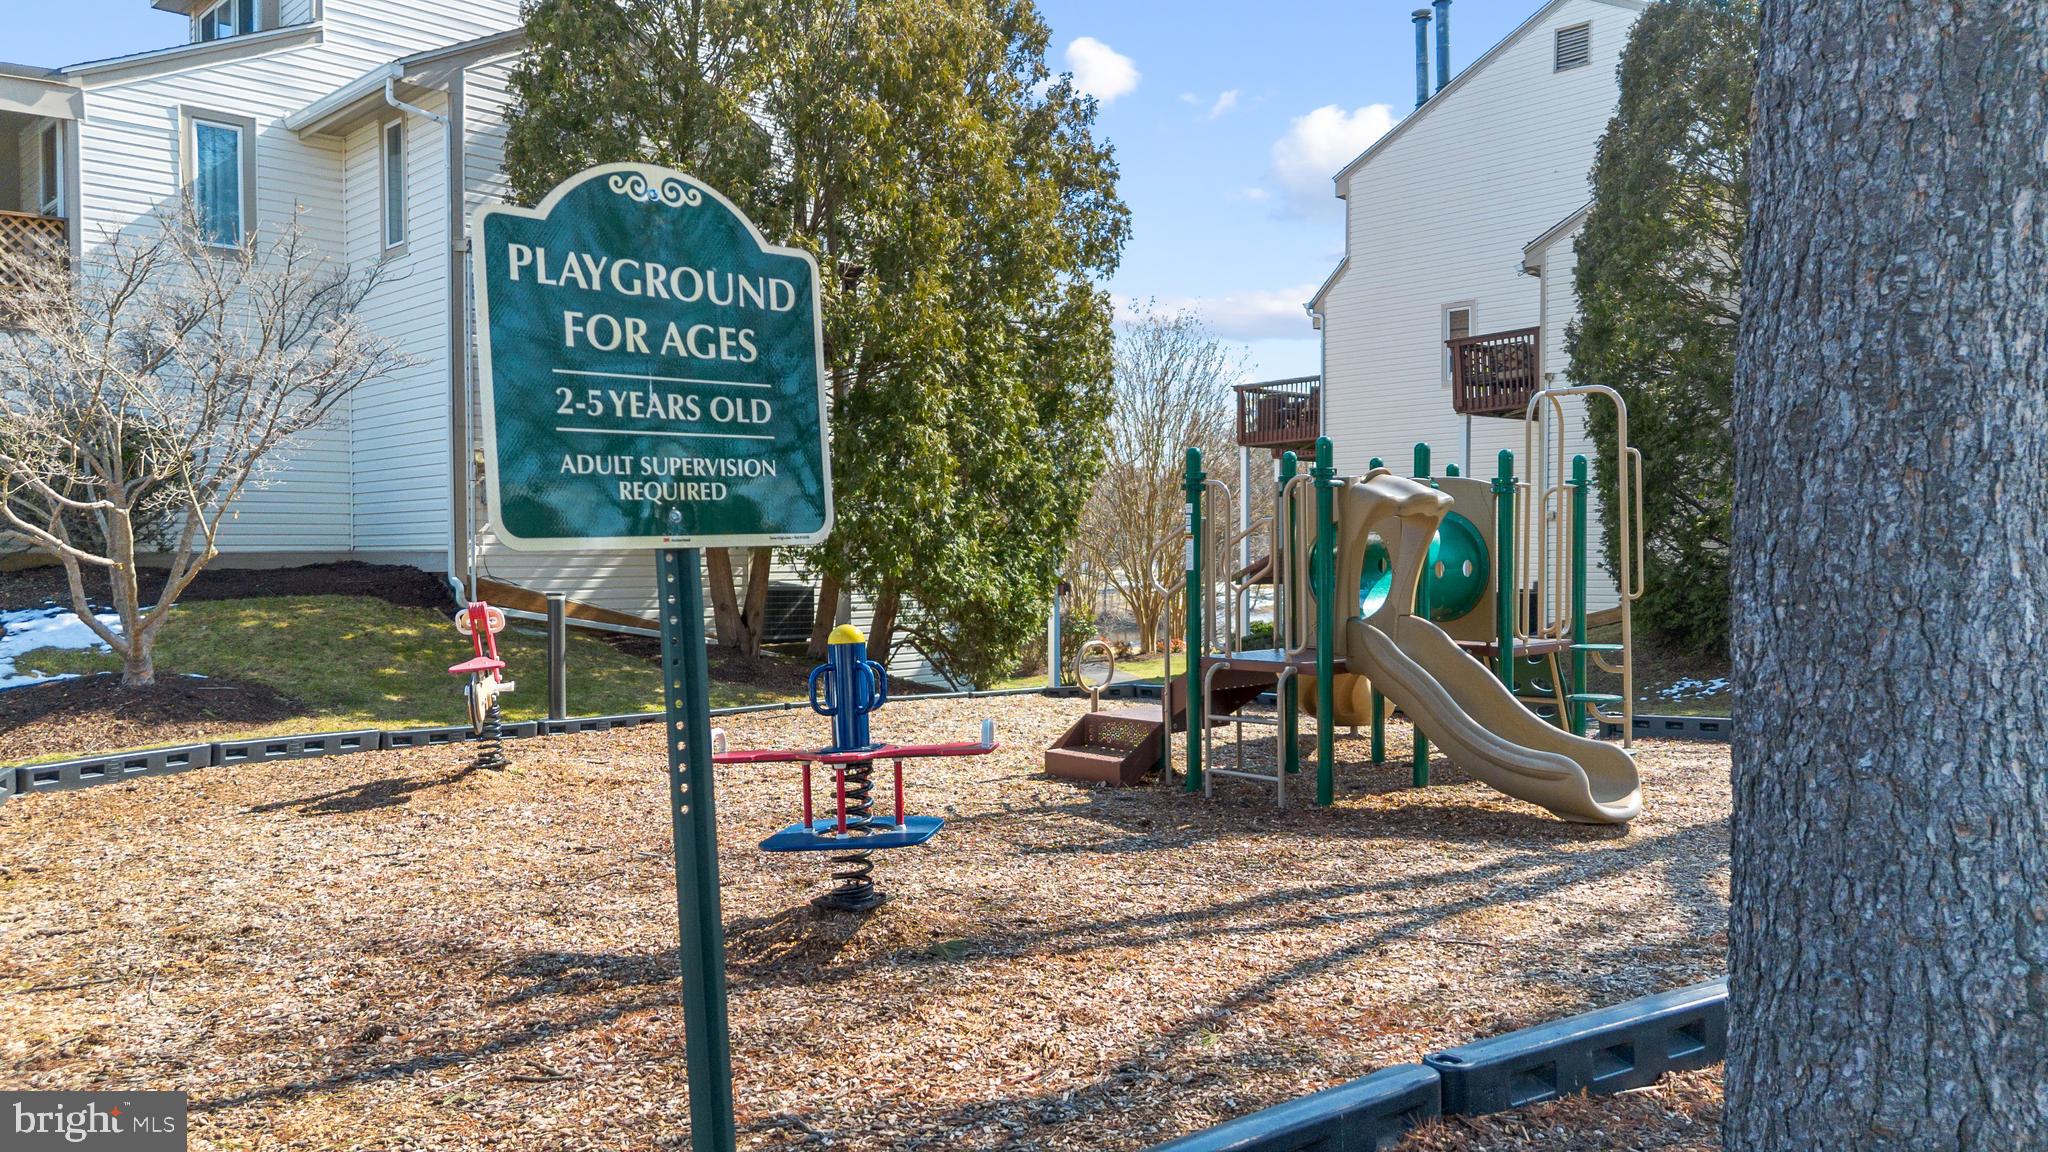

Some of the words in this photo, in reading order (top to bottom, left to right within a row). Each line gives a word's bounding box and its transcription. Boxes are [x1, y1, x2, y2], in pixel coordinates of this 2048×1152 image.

[508, 243, 796, 312] PLAYGROUND
[564, 311, 650, 354] FOR
[661, 322, 758, 363] AGES
[556, 387, 604, 416] 2-5
[608, 390, 701, 421] YEARS
[710, 396, 772, 424] OLD
[560, 454, 634, 475] ADULT
[640, 456, 776, 477] SUPERVISION
[619, 481, 727, 504] REQUIRED
